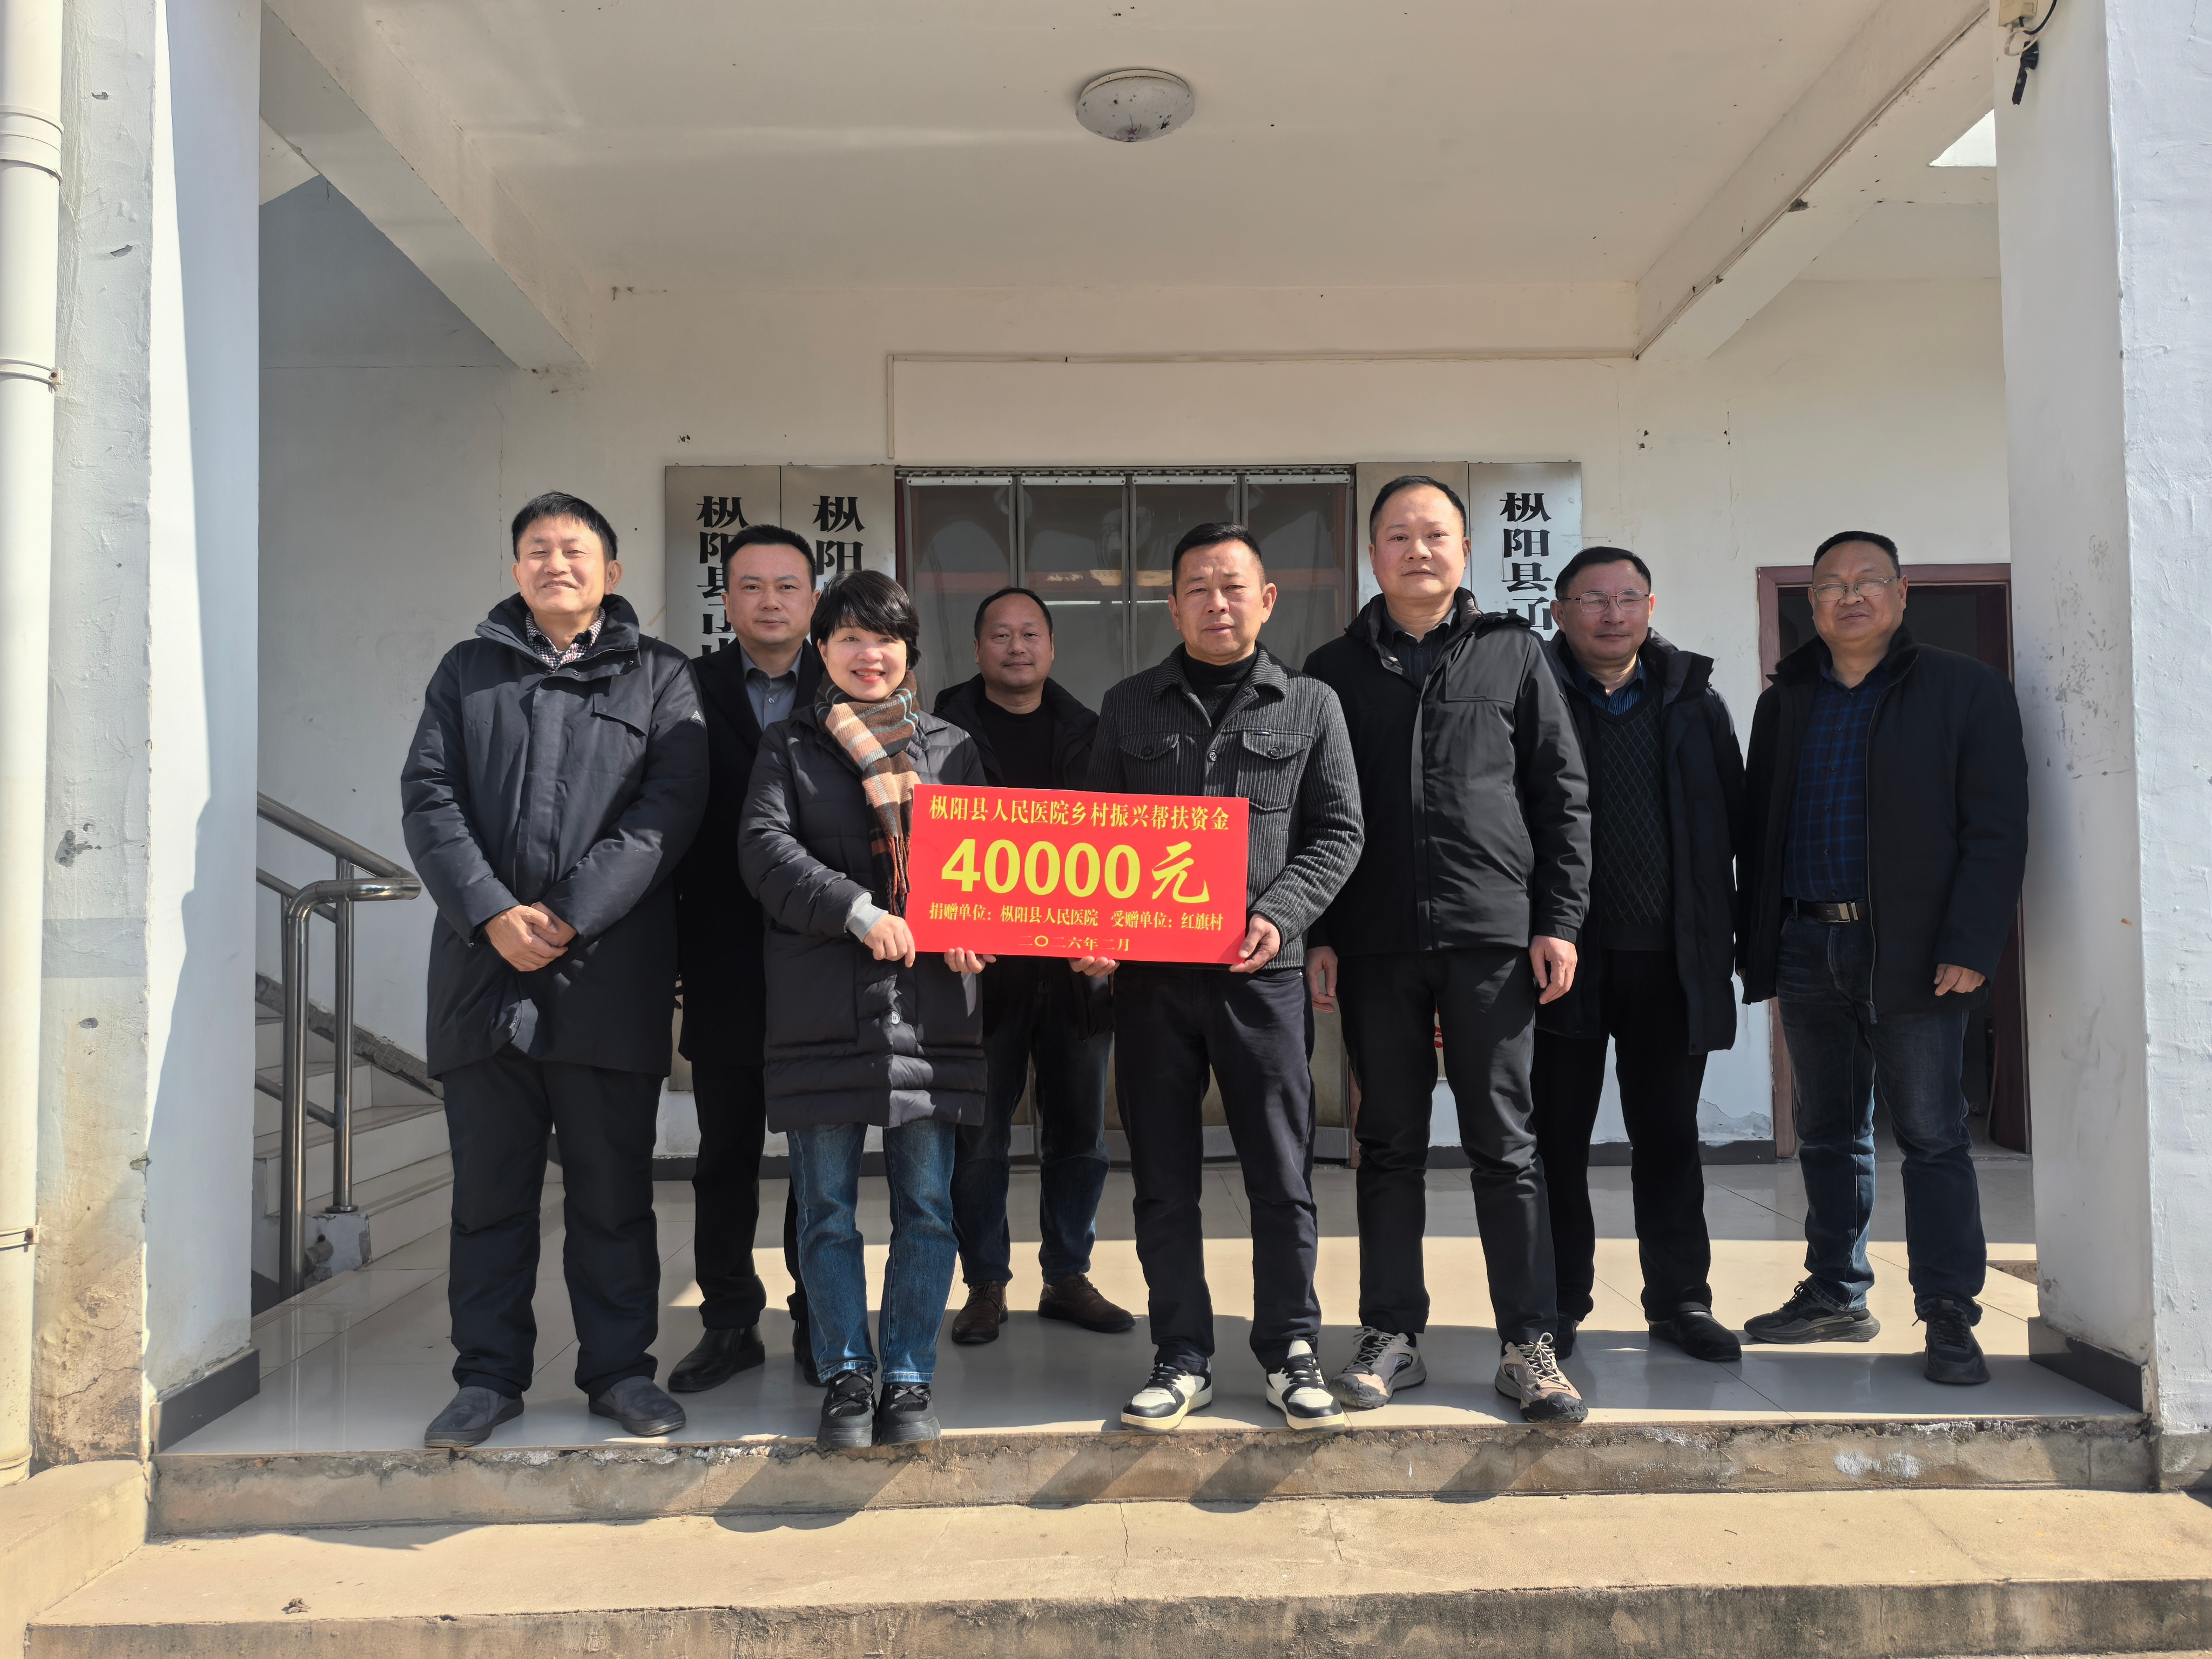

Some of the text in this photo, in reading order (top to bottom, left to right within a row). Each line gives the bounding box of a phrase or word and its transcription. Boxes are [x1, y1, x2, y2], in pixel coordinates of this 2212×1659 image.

[812, 495, 866, 588] 枞阳
[928, 794, 1230, 831] 枞阳县人民医院乡村振兴帮扶资金
